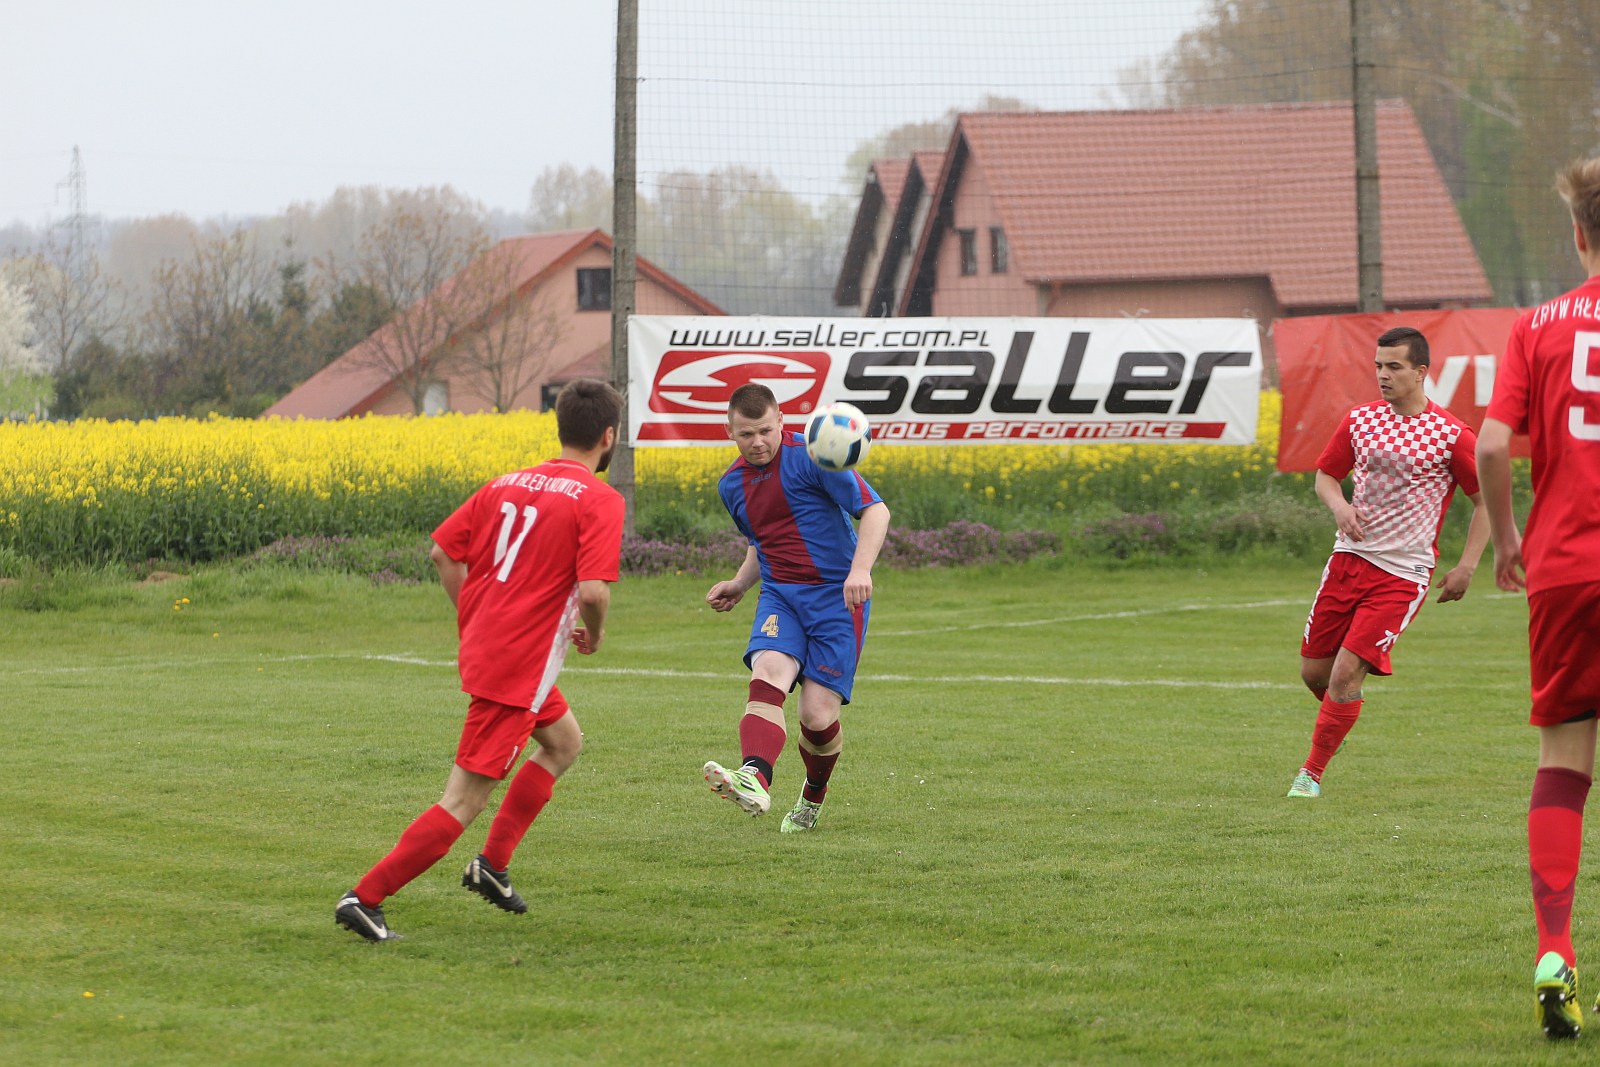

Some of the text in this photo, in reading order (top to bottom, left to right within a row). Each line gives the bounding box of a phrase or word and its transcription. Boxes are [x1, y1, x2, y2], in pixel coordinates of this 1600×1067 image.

[1568, 331, 1600, 441] 5
[485, 501, 538, 583] 11
[760, 614, 779, 638] 4
